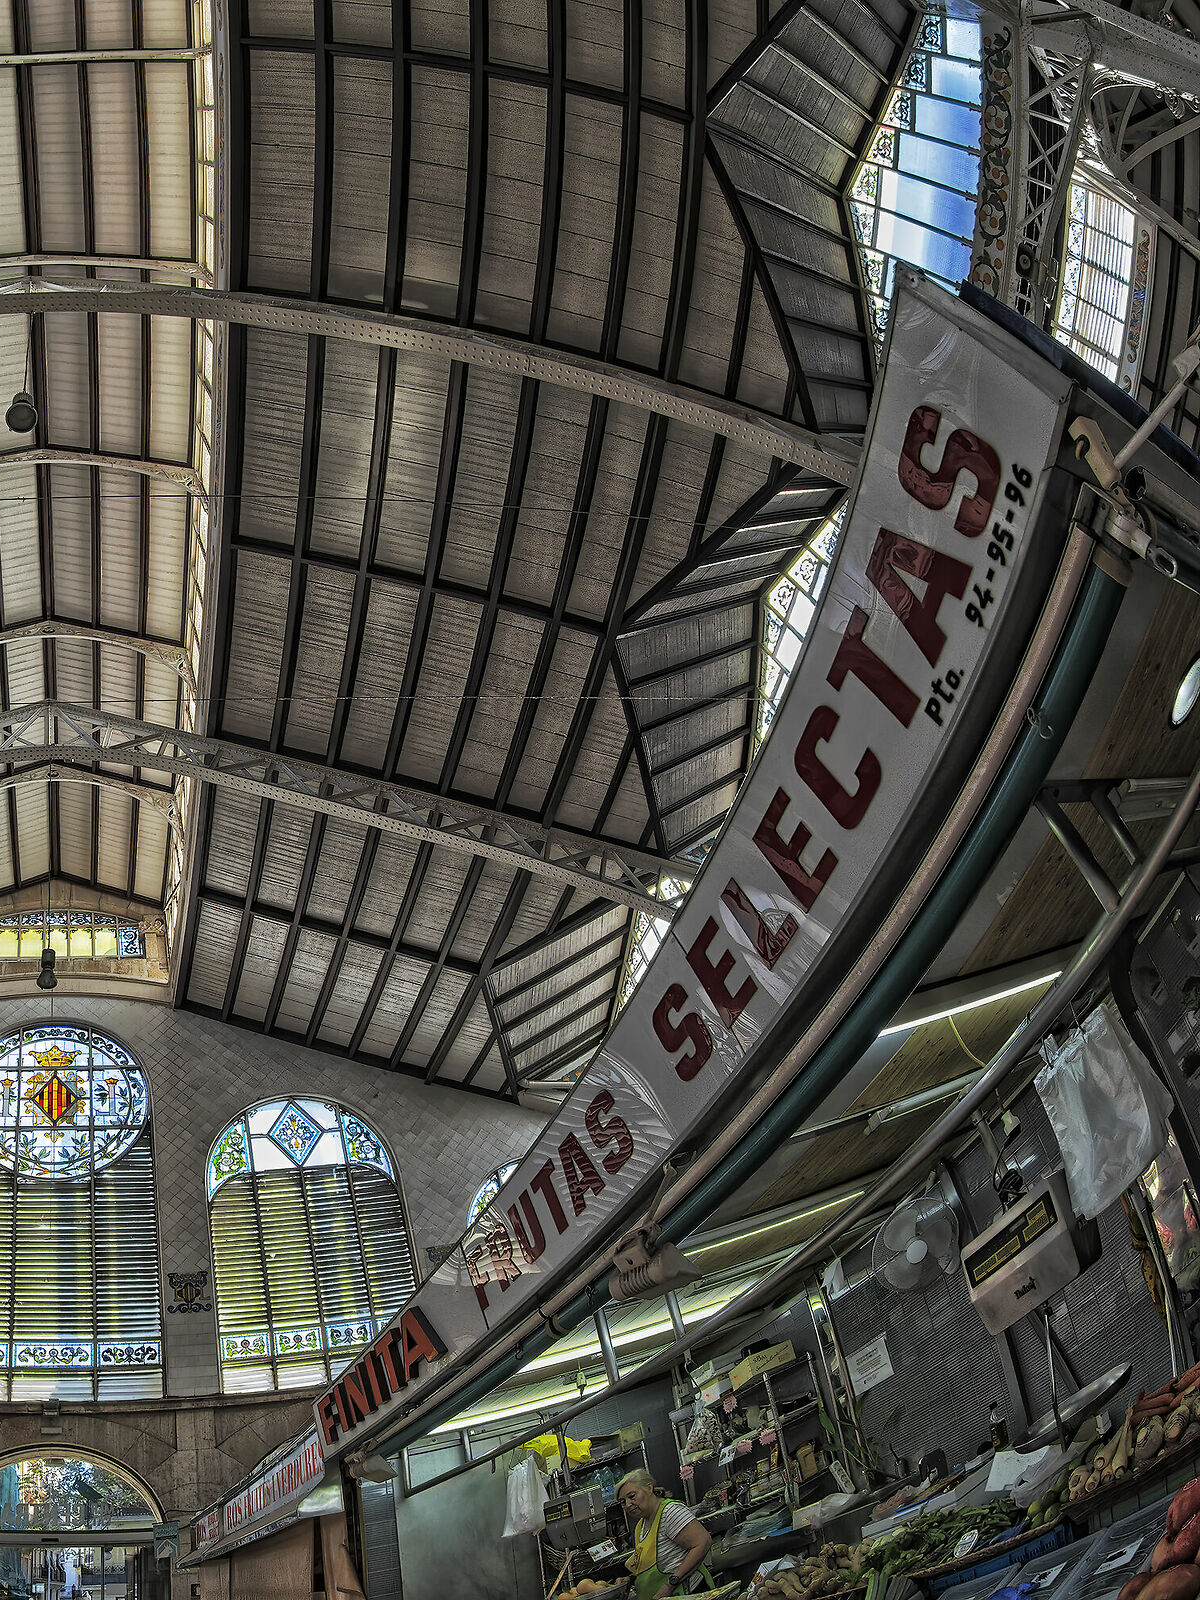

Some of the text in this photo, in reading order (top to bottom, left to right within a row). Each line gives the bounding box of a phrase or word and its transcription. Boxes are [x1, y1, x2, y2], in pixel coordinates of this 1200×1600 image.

[924, 463, 1033, 727] Pto. 94-95-96
[317, 405, 1002, 1446] FINITA FRUTAS SELECTAS
[226, 1498, 243, 1531] ROS
